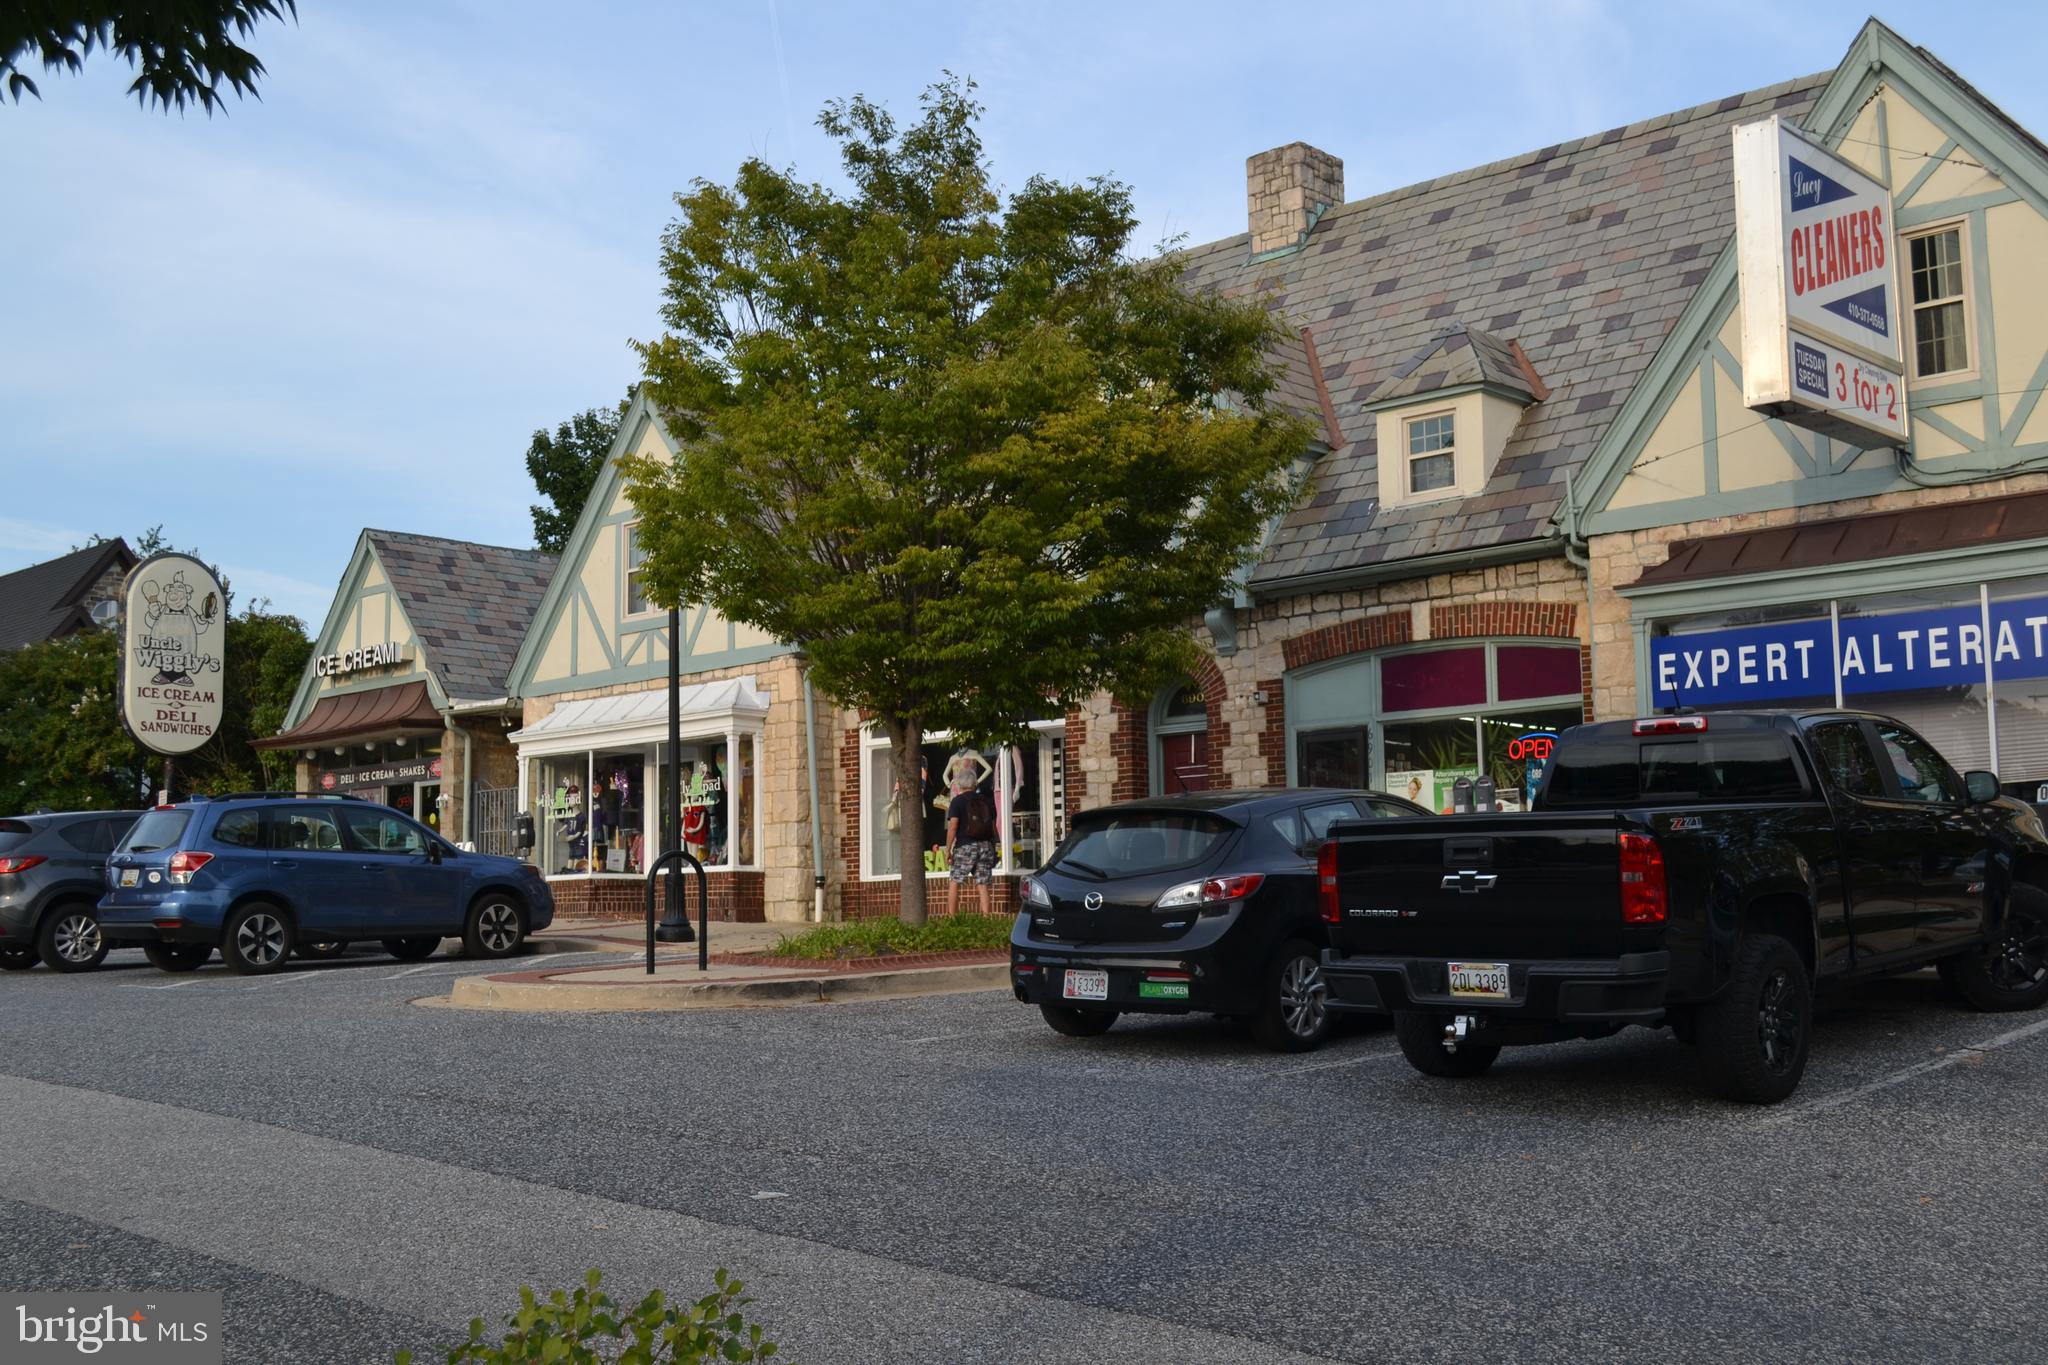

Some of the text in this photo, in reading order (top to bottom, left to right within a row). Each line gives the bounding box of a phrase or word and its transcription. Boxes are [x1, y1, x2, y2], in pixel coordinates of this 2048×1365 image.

[1793, 171, 1821, 203] Lucy
[1791, 206, 1885, 296] CLEANERS
[1796, 348, 1826, 374] TUESDAY
[1798, 368, 1827, 392] SPECIAL
[1836, 362, 1897, 421] 3 for 2
[138, 634, 182, 651] Uncle
[1658, 615, 2048, 691] EXPERT ALTERAT
[134, 647, 221, 675] Wiggly's
[313, 641, 396, 678] ICE CREAM
[137, 687, 215, 703] ICE CREAM
[156, 709, 197, 722] DELI
[140, 721, 212, 736] SANDWICHES
[340, 774, 355, 785] DELI
[359, 771, 370, 782] ICE
[371, 768, 395, 781] CREAM
[400, 764, 426, 777] SHAKES
[703, 776, 721, 797] pad
[1349, 909, 1399, 917] COLORADO
